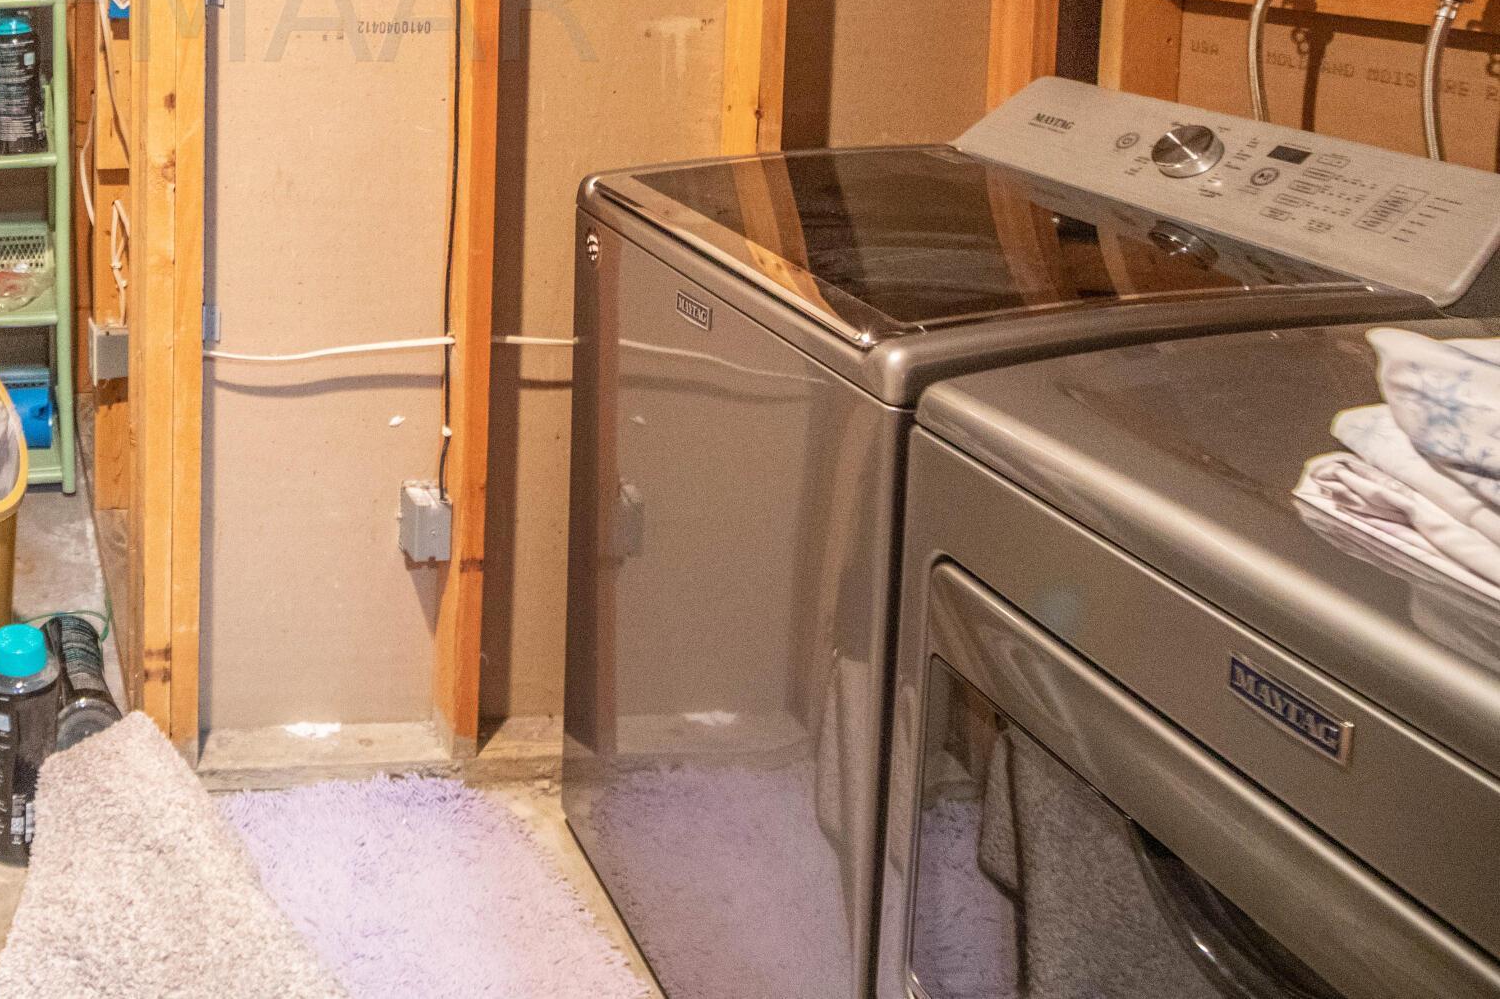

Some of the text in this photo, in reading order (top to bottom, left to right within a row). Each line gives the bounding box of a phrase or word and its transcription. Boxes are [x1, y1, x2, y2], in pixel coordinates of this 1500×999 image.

[1366, 67, 1469, 97] MOISRE
[1034, 113, 1076, 130] MAYTAG
[1232, 662, 1342, 747] MAYTAG
